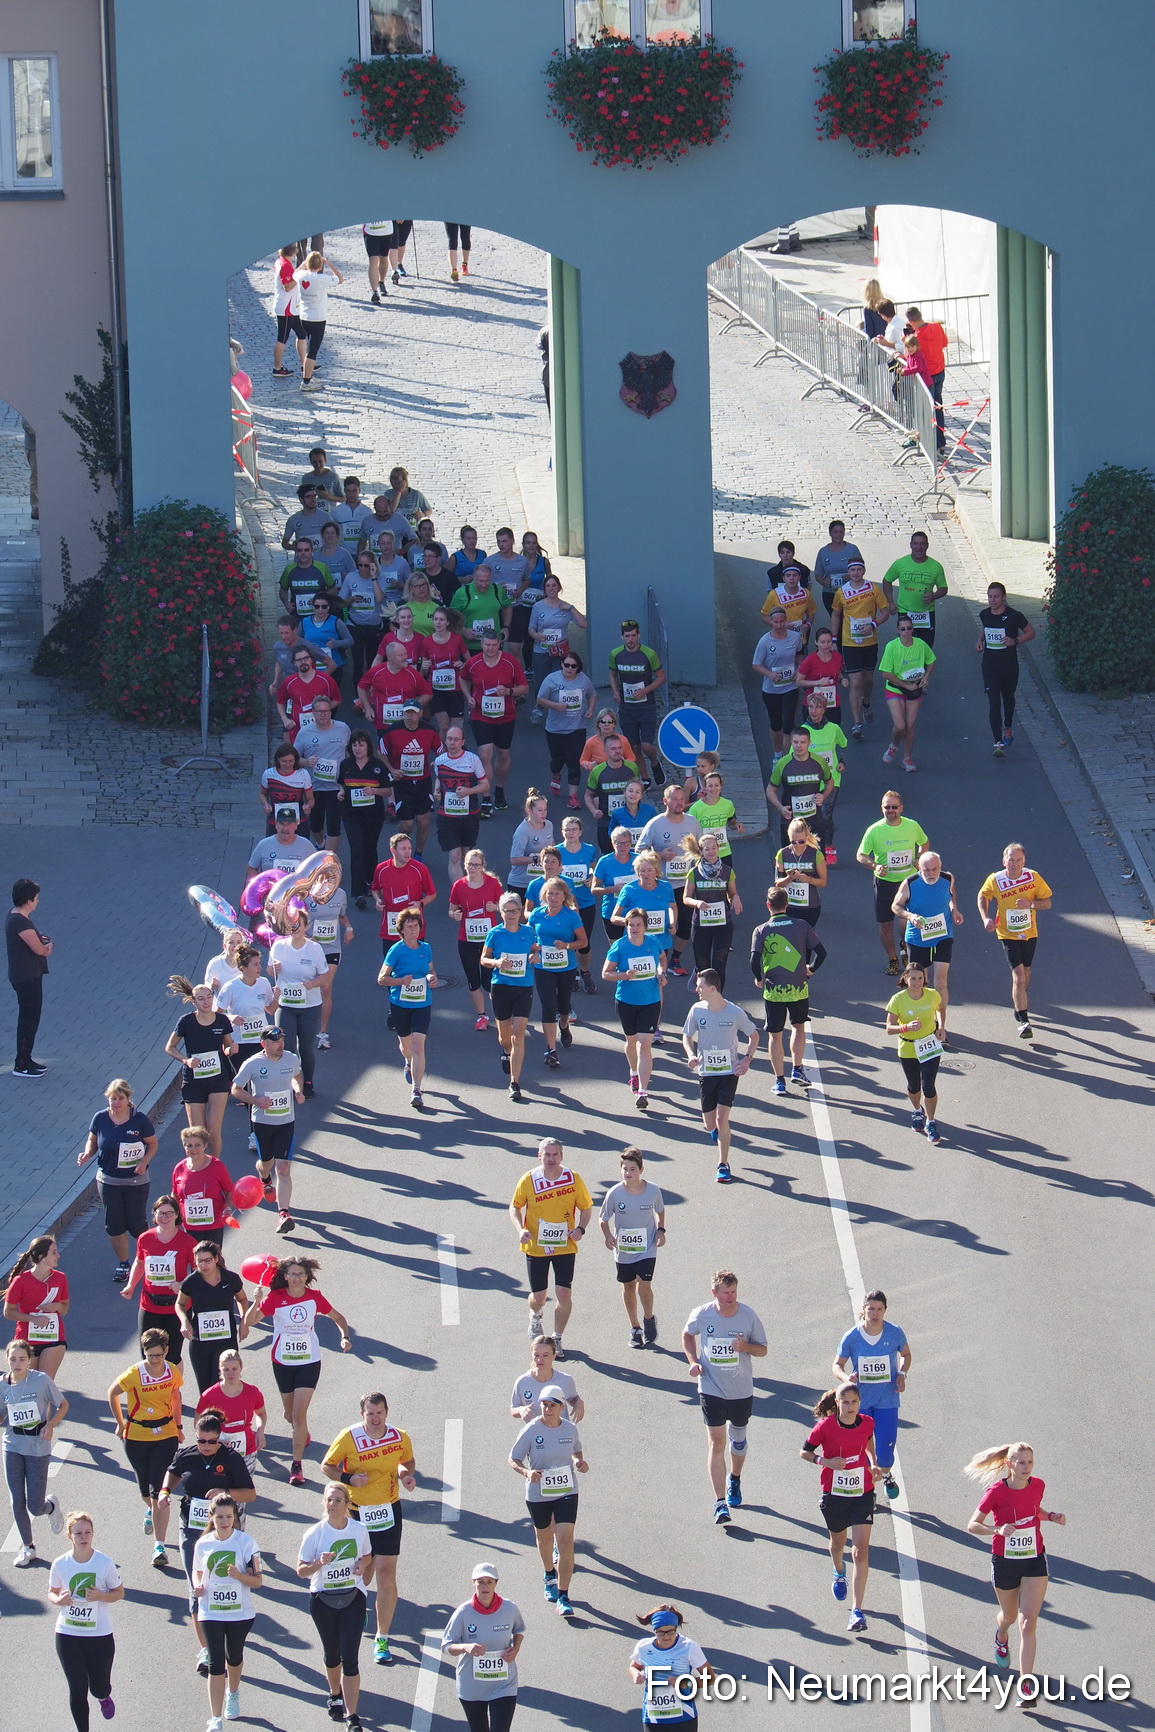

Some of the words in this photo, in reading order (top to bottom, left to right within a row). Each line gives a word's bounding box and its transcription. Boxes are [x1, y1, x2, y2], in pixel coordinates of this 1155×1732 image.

[291, 579, 319, 587] BOCK
[845, 597, 859, 606] MAX
[859, 591, 875, 600] BÖGL
[545, 634, 558, 642] 057
[618, 664, 646, 672] BOCK
[779, 669, 792, 678] 199
[484, 701, 502, 709] 5117
[316, 763, 334, 772] 5207
[404, 760, 421, 768] 5132
[787, 773, 820, 783] BOCK
[601, 781, 627, 790] BOC
[891, 855, 908, 864] 5217
[670, 862, 686, 870] 5033
[565, 871, 584, 879] 5042
[788, 888, 805, 896] 5143
[1001, 890, 1017, 899] MAX
[1018, 883, 1036, 892] BÖGL
[703, 908, 722, 916] 5145
[648, 917, 661, 925] 038
[469, 925, 488, 933] 5115
[545, 952, 564, 960] 5035
[633, 962, 651, 972] 5041
[283, 988, 302, 997] 5103
[405, 984, 424, 993] 5040
[243, 1020, 263, 1031] 5102
[918, 1039, 936, 1052] 5151
[708, 1055, 727, 1064] 5154
[123, 1149, 141, 1158] 5137
[535, 1193, 555, 1203] MAX
[556, 1187, 576, 1198] BÖGL
[188, 1205, 208, 1215] 5127
[541, 1228, 564, 1238] 5097
[621, 1234, 643, 1244] 5045
[149, 1263, 170, 1272] 5174
[203, 1319, 225, 1329] 5034
[285, 1342, 307, 1351] 5166
[711, 1345, 734, 1355] 5219
[863, 1363, 886, 1372] 5169
[159, 1382, 173, 1390] BÖG
[13, 1410, 34, 1421] 5017
[358, 1451, 379, 1462] MAX
[381, 1443, 404, 1456] BÖGL
[545, 1474, 569, 1486] 5193
[838, 1476, 860, 1486] 5108
[193, 1507, 209, 1517] 505
[365, 1508, 388, 1521] 5099
[1009, 1537, 1032, 1547] 5109
[327, 1567, 351, 1580] 5048
[213, 1591, 237, 1601] 5049
[69, 1606, 92, 1617] 5047
[479, 1658, 504, 1669] 5019
[651, 1695, 676, 1706] 5064
